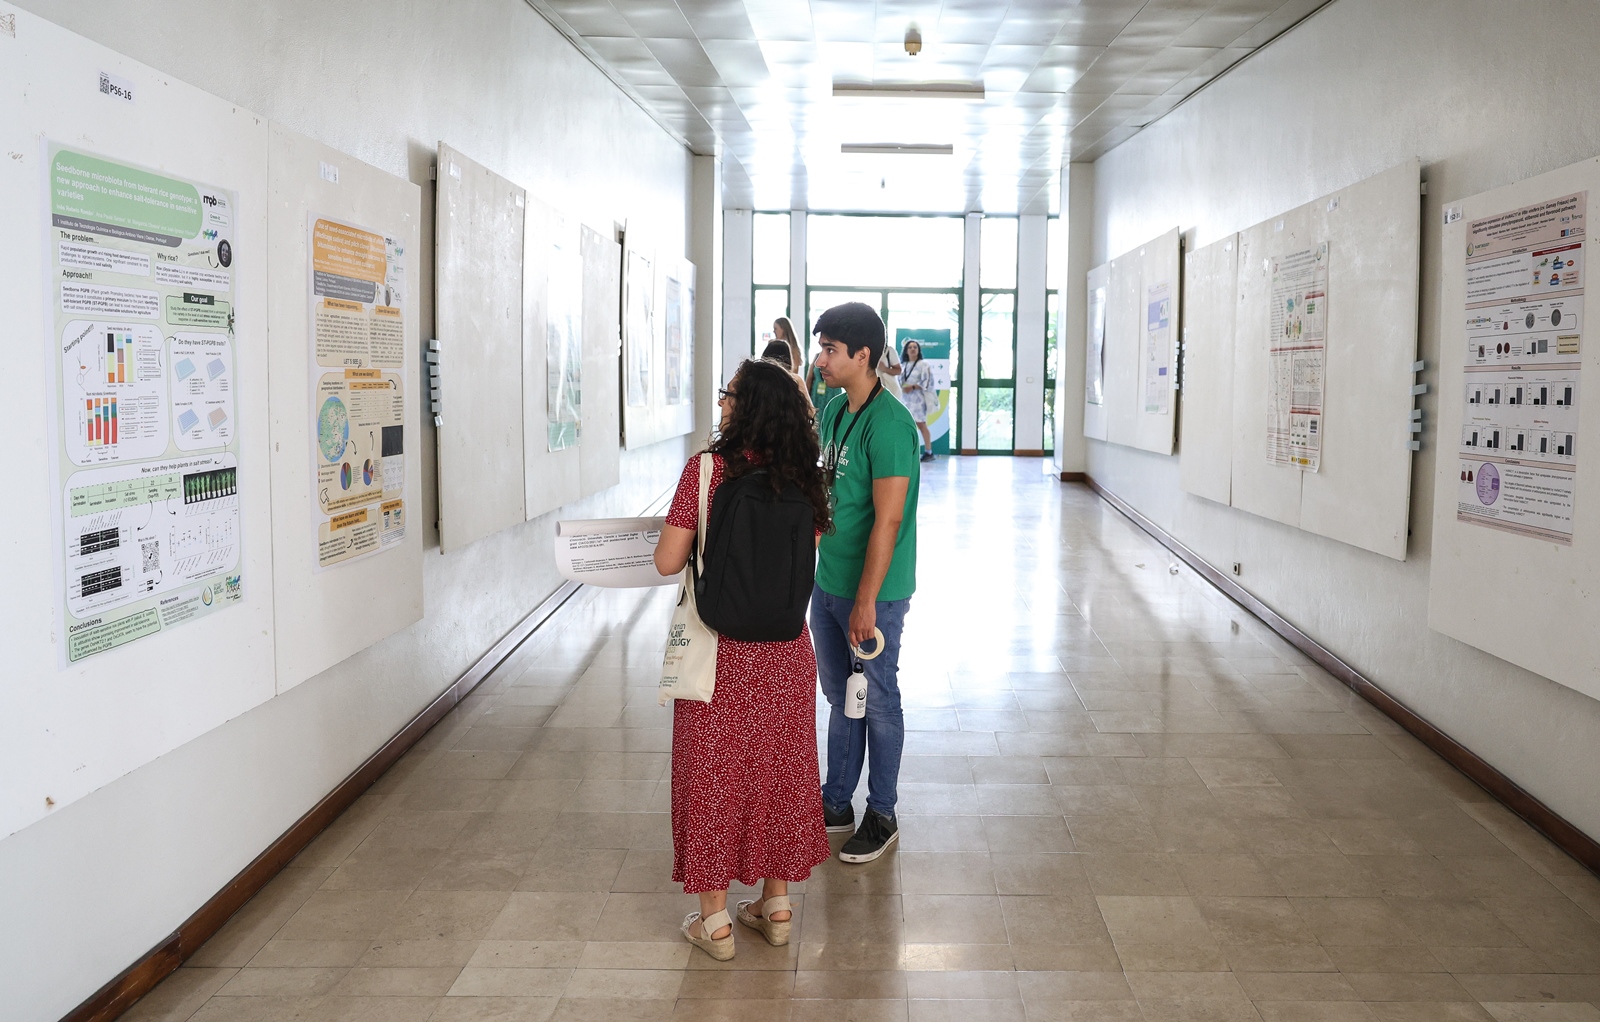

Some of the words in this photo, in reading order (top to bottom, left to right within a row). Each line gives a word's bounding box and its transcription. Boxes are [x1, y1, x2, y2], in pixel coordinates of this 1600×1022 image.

[110, 84, 131, 100] PS6-16
[56, 162, 90, 178] Seedborne
[92, 173, 122, 186] microbiota
[124, 180, 136, 190] from
[138, 184, 158, 195] tolerant
[159, 188, 169, 197] rice
[56, 176, 70, 185] new
[72, 179, 100, 192] approach
[101, 186, 108, 194] to
[108, 188, 133, 200] enhance
[176, 204, 197, 215] sensitive
[57, 188, 84, 201] varieties
[60, 231, 70, 239] The
[157, 252, 167, 261] Why
[69, 617, 102, 633] Conclusions
